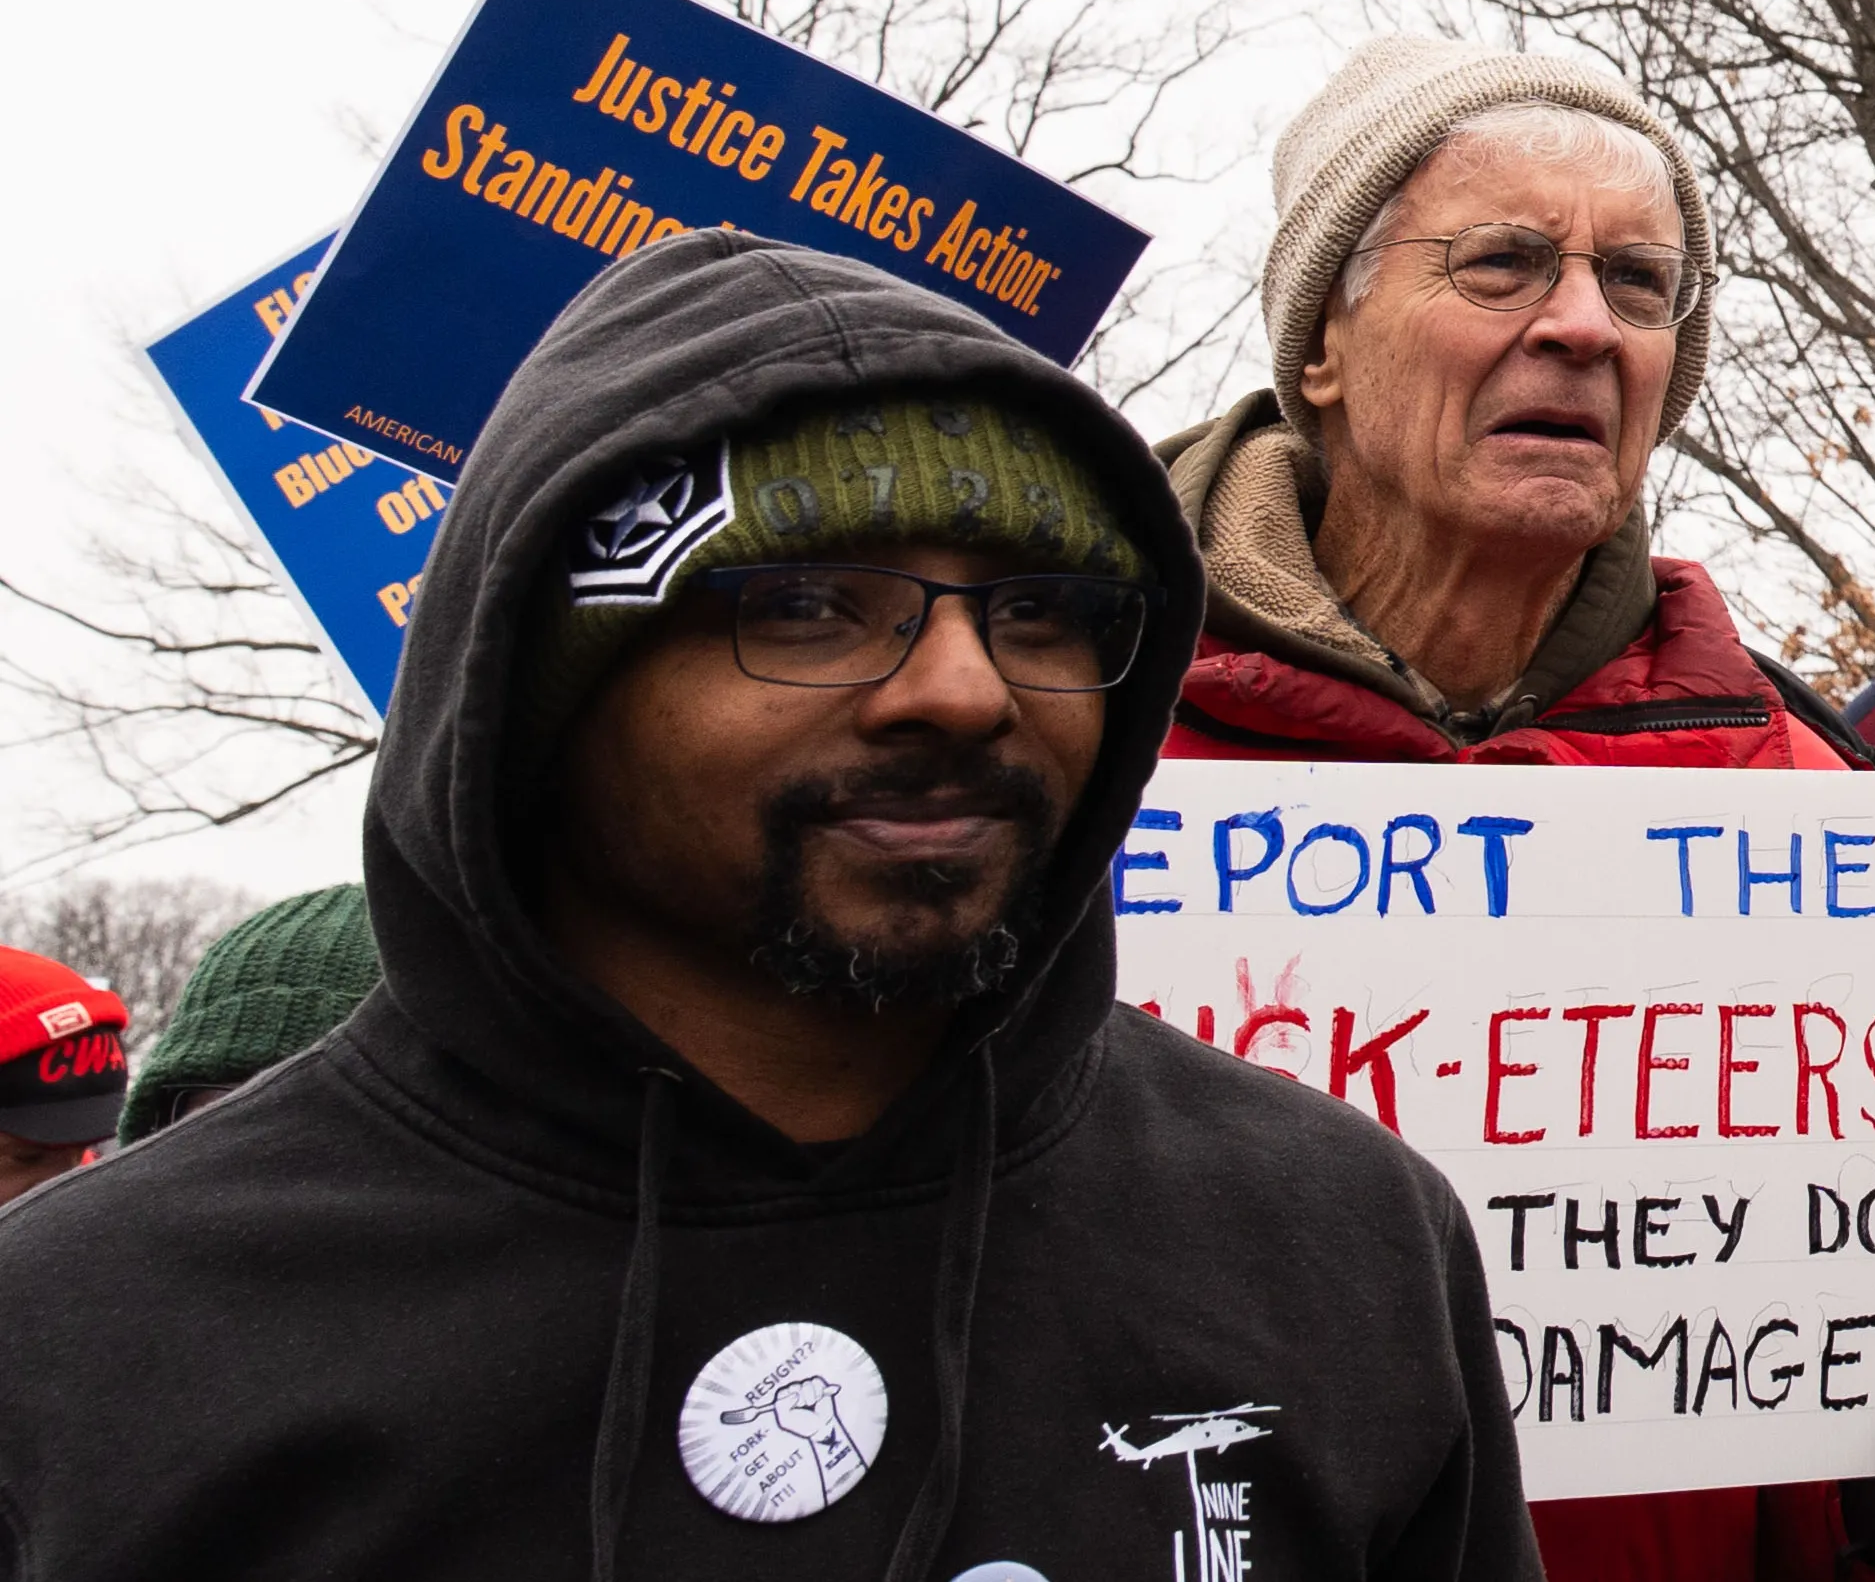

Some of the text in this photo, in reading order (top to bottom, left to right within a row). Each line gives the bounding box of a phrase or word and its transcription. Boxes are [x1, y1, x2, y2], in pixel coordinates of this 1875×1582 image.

[572, 33, 1062, 316] Justice Takes Action:
[345, 405, 463, 464] AMERICAN
[1488, 1194, 1750, 1272] THEY
[744, 1341, 816, 1405] RESIGN??
[728, 1427, 770, 1464] FORK-
[744, 1452, 770, 1478] GET
[759, 1449, 803, 1492] ABOUT
[1202, 1482, 1252, 1521] NINE
